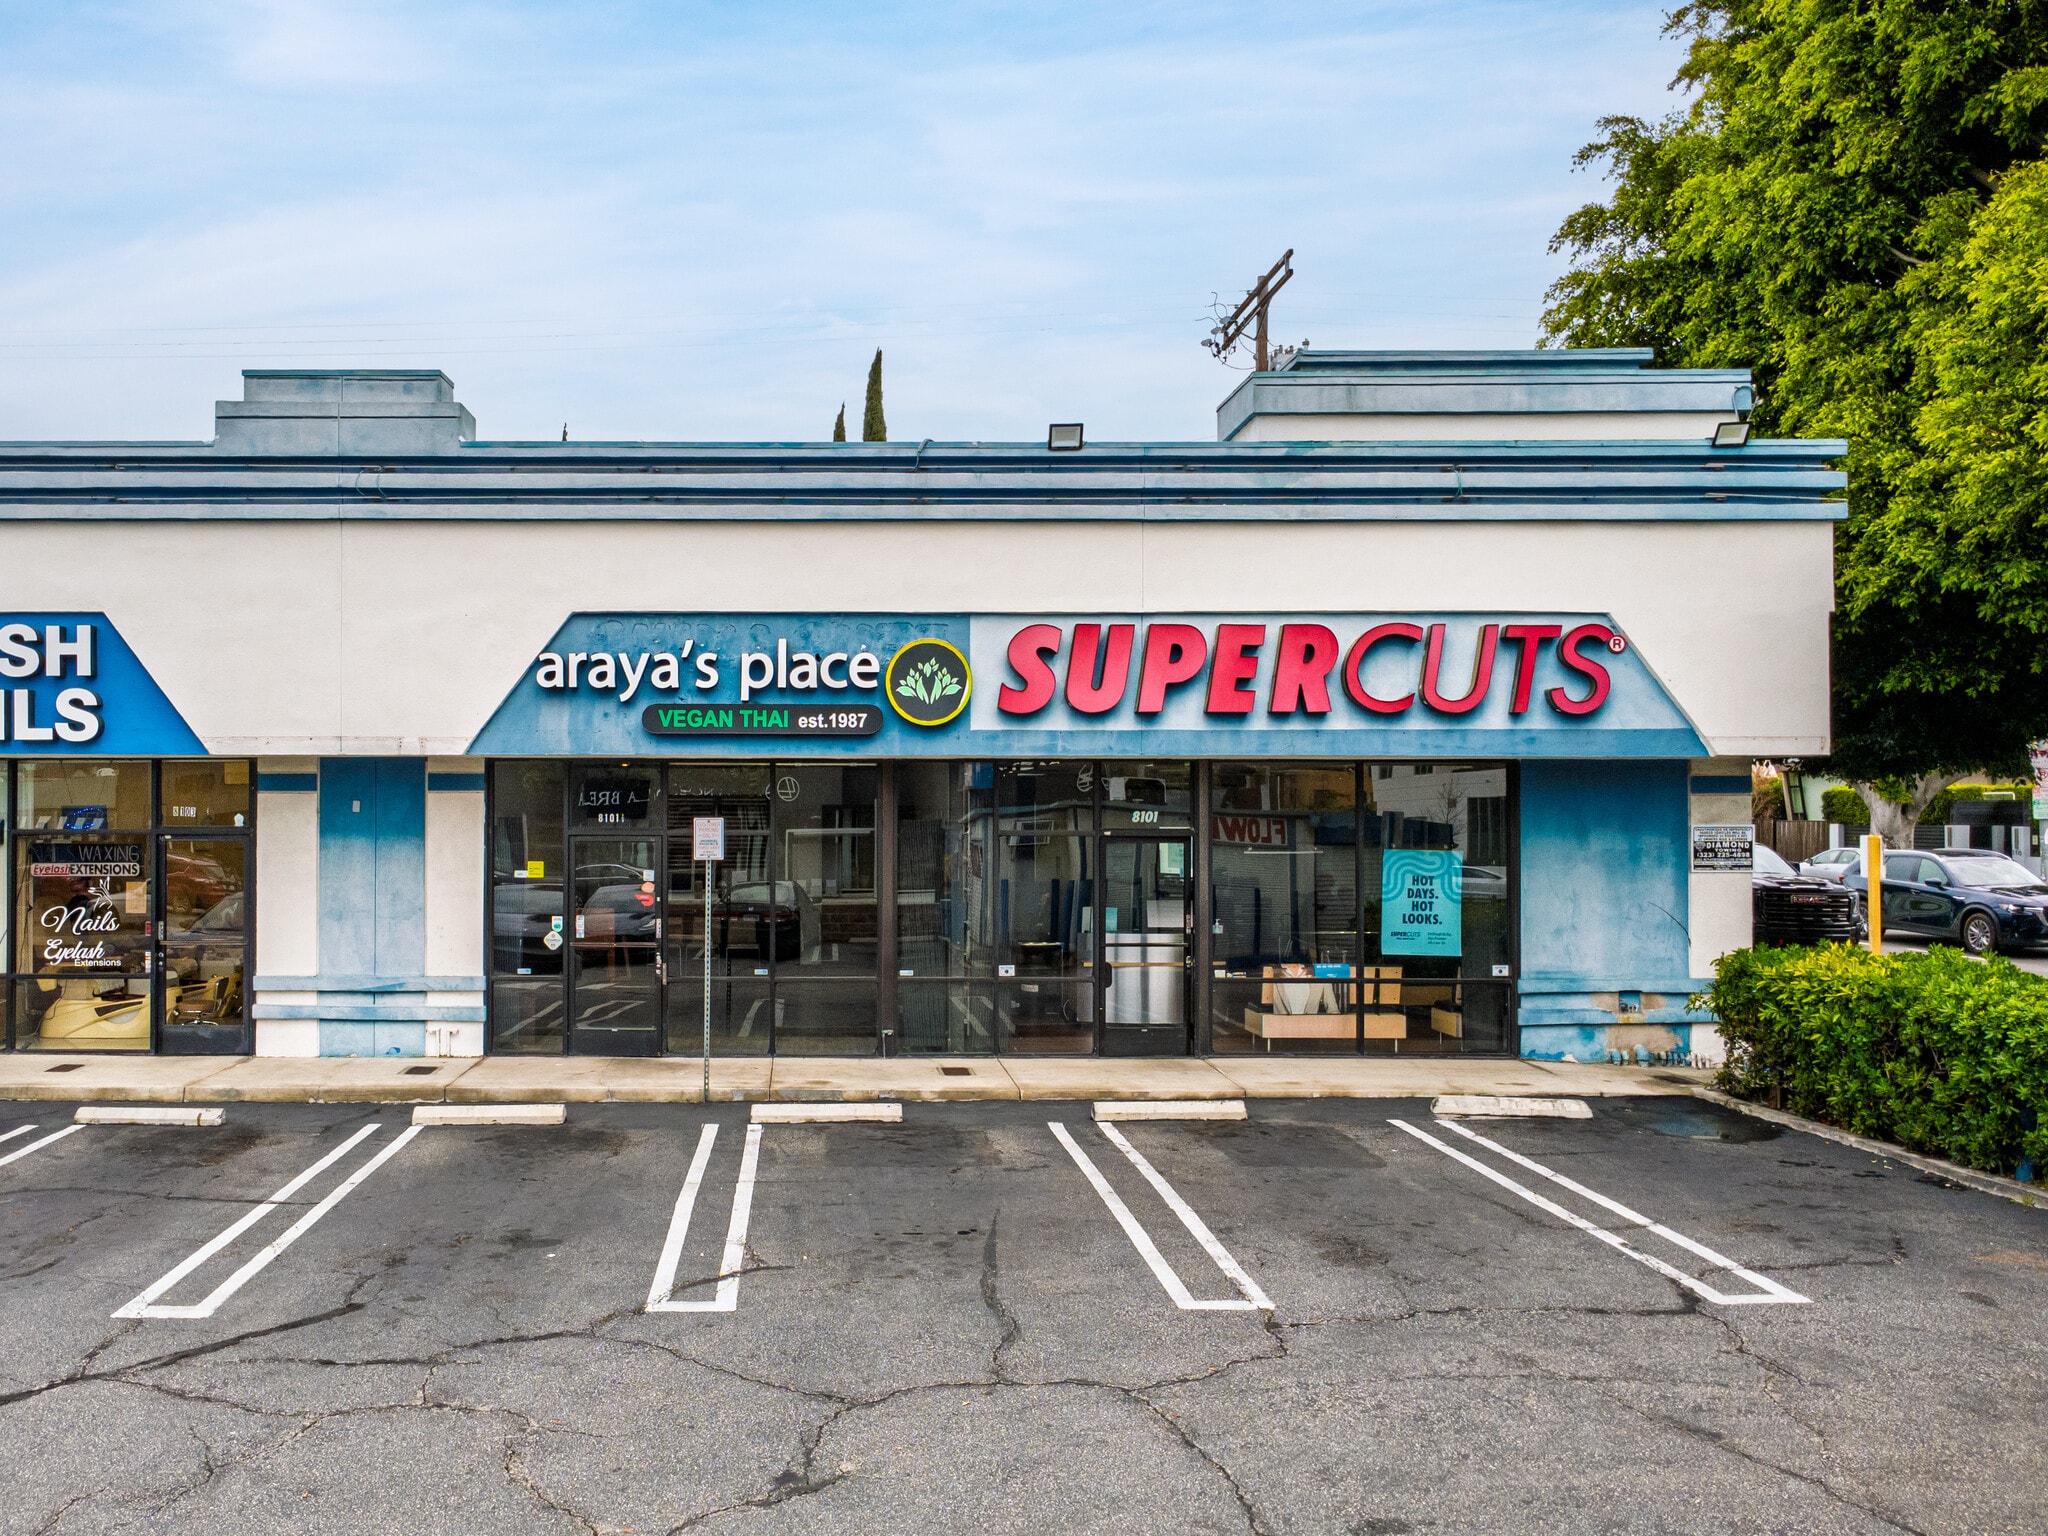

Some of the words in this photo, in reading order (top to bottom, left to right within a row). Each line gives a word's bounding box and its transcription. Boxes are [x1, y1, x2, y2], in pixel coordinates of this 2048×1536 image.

[0, 623, 92, 678] SH
[535, 639, 720, 702] araya's
[740, 638, 881, 702] place
[658, 709, 734, 729] VEGAN
[739, 709, 789, 728] THAI
[798, 713, 868, 729] est.1987
[1131, 810, 1159, 823] 8101
[1706, 841, 1750, 849] DIAMOND
[78, 845, 140, 863] WAXING
[33, 864, 71, 876] Eyelash
[70, 864, 139, 875] EXTENSIONS
[1411, 875, 1435, 887] HOT
[1407, 888, 1439, 900] DAYS.
[1411, 901, 1435, 912] HOT
[41, 905, 120, 935] Nails
[1402, 913, 1443, 925] LOOKS.
[43, 938, 106, 966] Eyelash
[74, 959, 122, 967] Extensions
